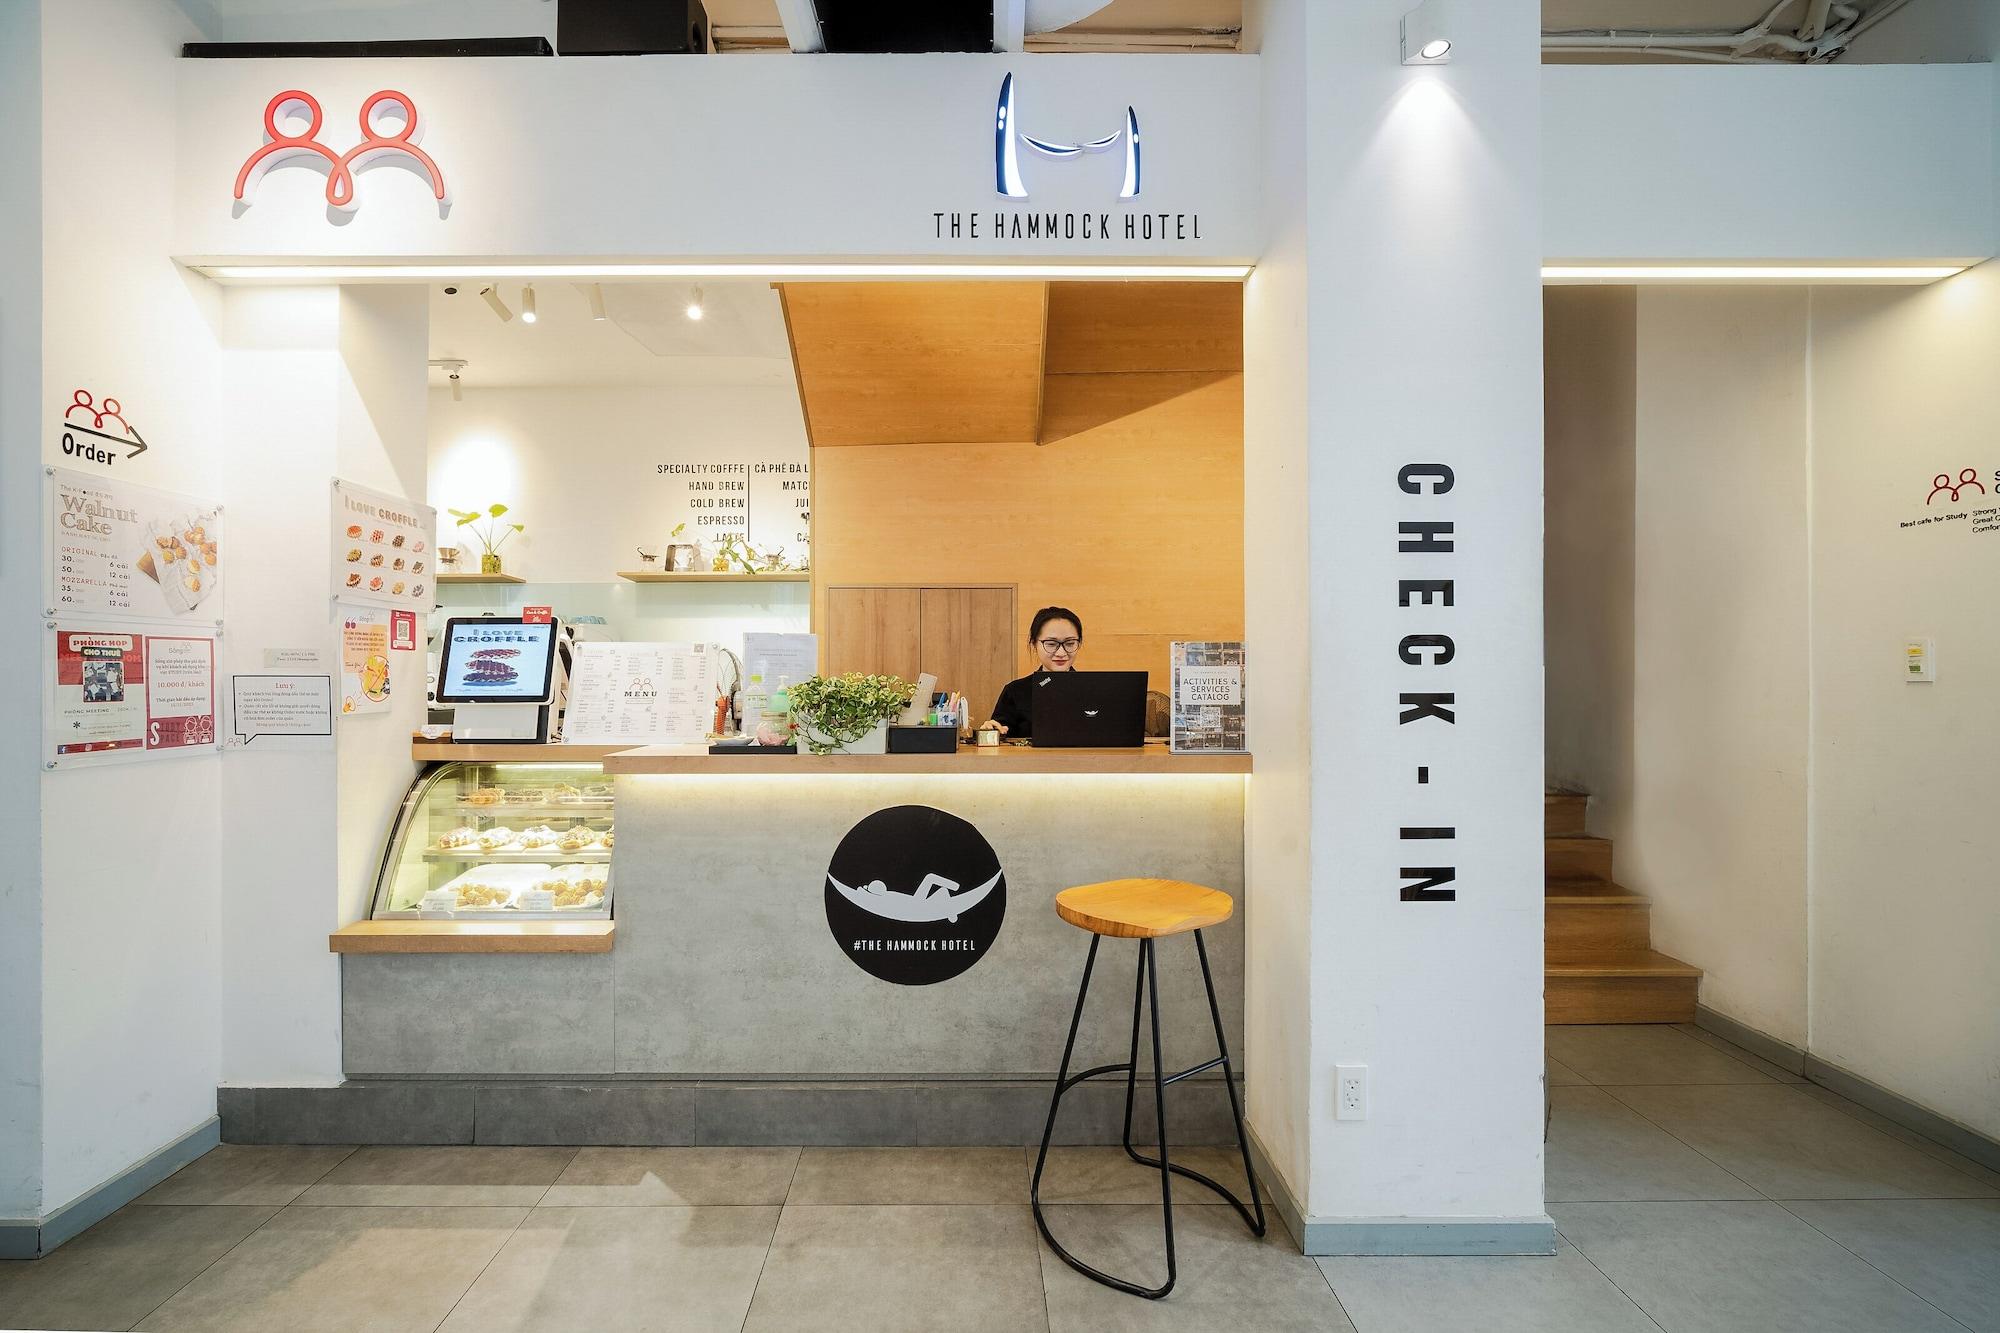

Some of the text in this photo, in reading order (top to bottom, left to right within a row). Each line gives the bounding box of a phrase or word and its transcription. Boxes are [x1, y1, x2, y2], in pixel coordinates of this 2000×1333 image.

[933, 213, 1201, 240] THE HAMMOCK HOTEL
[62, 432, 117, 466] Order
[657, 464, 708, 474] SPECIALTY
[688, 481, 745, 491] HAND BREW
[782, 481, 810, 491] MATC
[690, 498, 745, 508] COLD BREW
[60, 494, 138, 524] Walnut
[350, 500, 376, 517] LOVE
[378, 508, 418, 528] CROFFLE
[1972, 508, 1997, 517] Strong
[60, 512, 113, 536] Cake
[697, 515, 745, 526] ESPRESSO
[1900, 520, 1916, 528] Best
[1945, 512, 1968, 521] Study
[1972, 516, 1993, 525] Great
[61, 546, 97, 557] ORIGINAL
[61, 576, 107, 587] MOZZARELLA
[453, 635, 541, 643] CROFFLE
[83, 648, 101, 656] CHO
[624, 690, 658, 698] MENU
[1190, 685, 1231, 693] SERVICES
[1191, 693, 1230, 701] CATALOG
[853, 939, 976, 951] #THE HAMMOCK HOTEL
